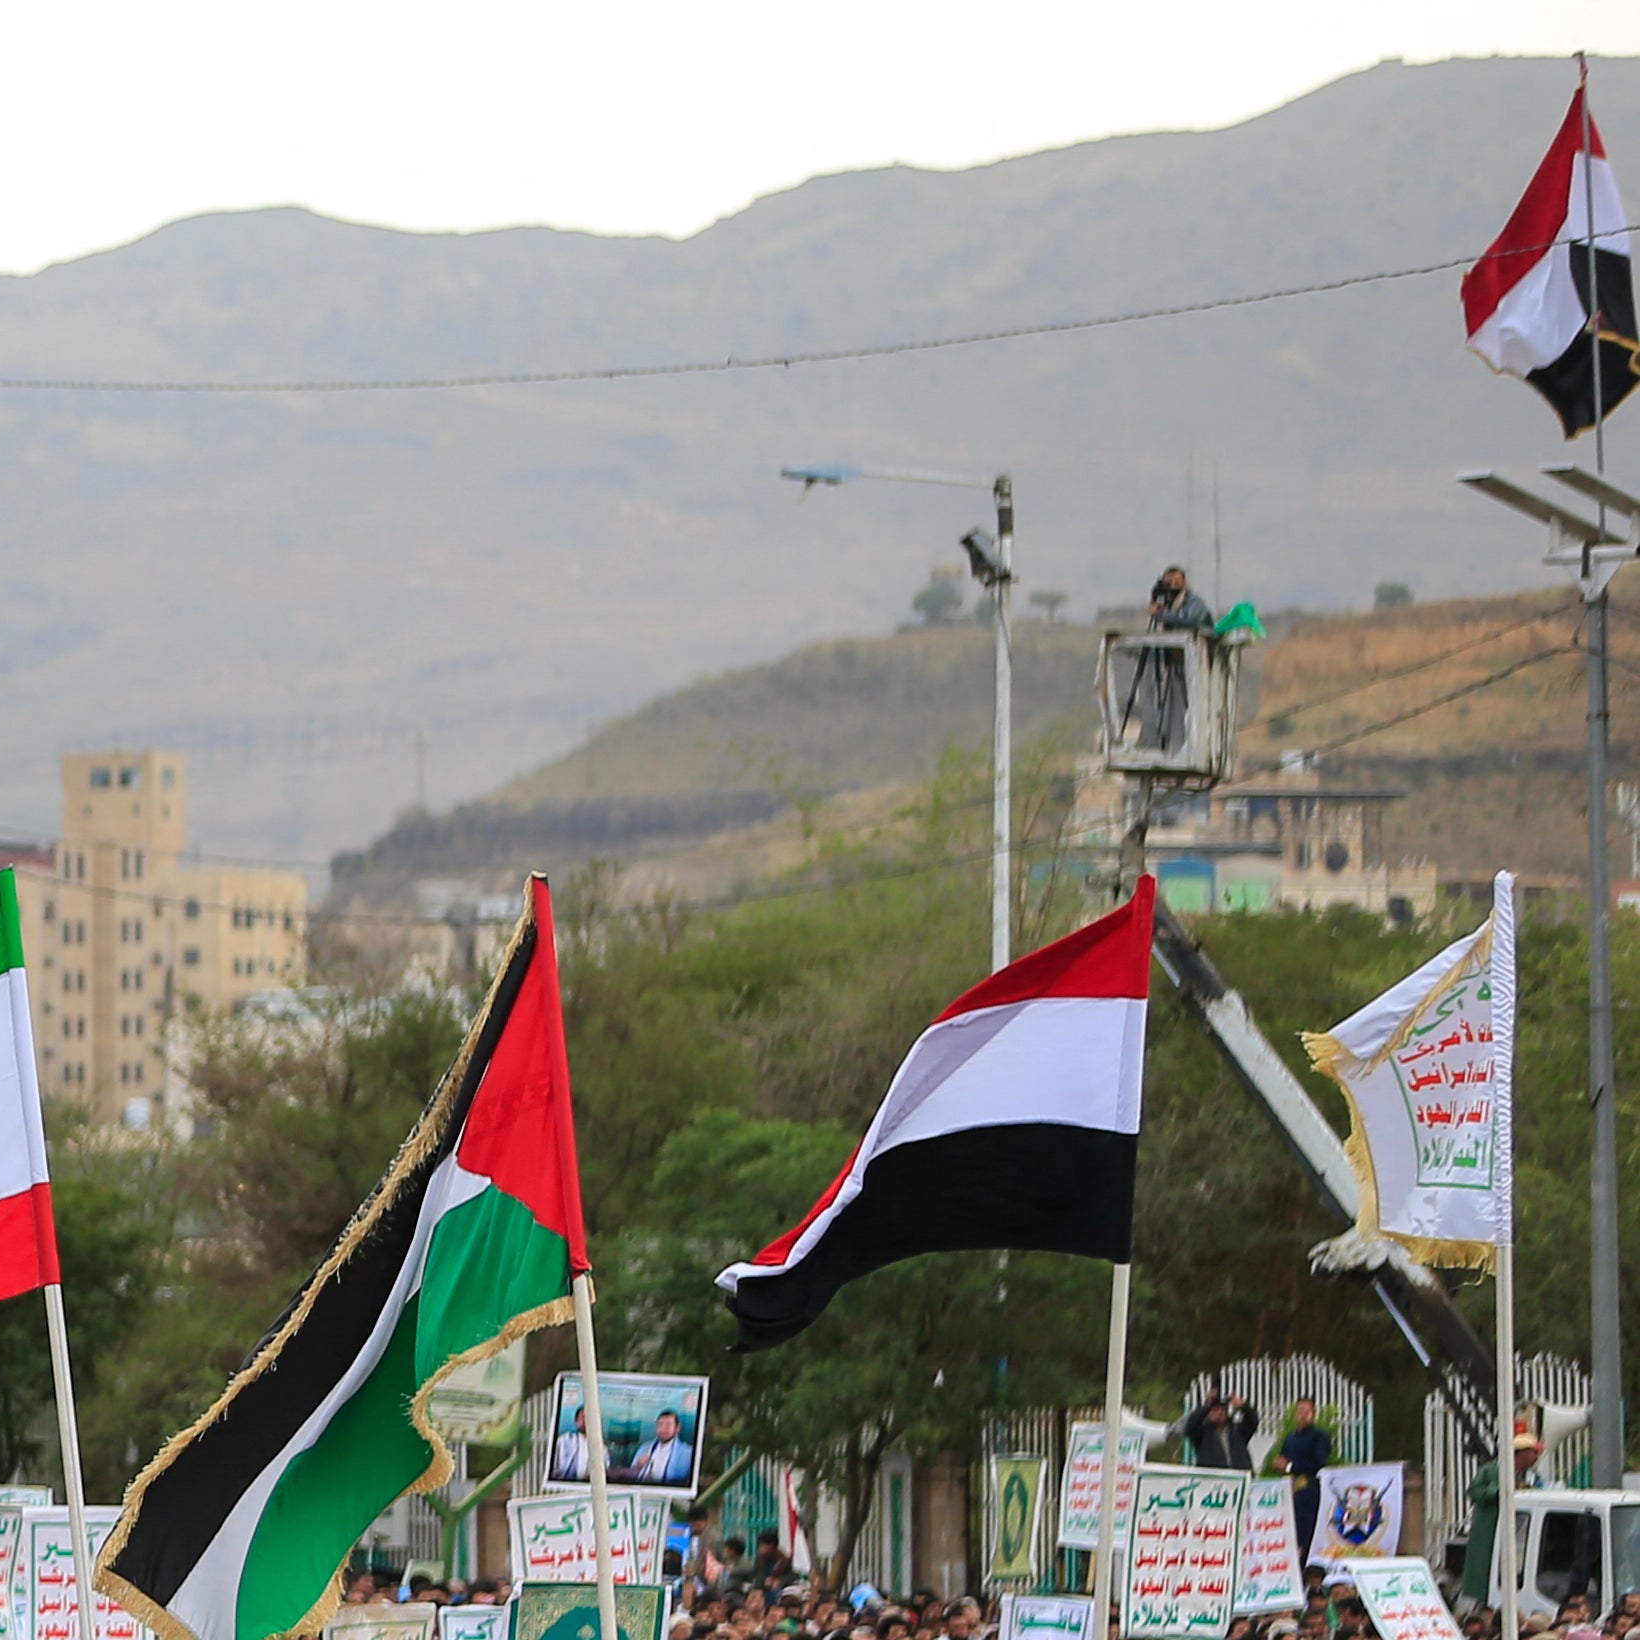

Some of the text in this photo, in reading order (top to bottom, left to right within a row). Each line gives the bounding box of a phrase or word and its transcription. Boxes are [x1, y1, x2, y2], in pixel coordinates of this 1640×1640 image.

[1145, 1478, 1239, 1518] الله أكبر
[1138, 1517, 1232, 1540] الموت لأمريكا
[1134, 1549, 1230, 1569] الموت لإسرائيل
[1133, 1577, 1229, 1599] اللعنة على اليهود
[1131, 1600, 1229, 1631] النصر للإسلام
